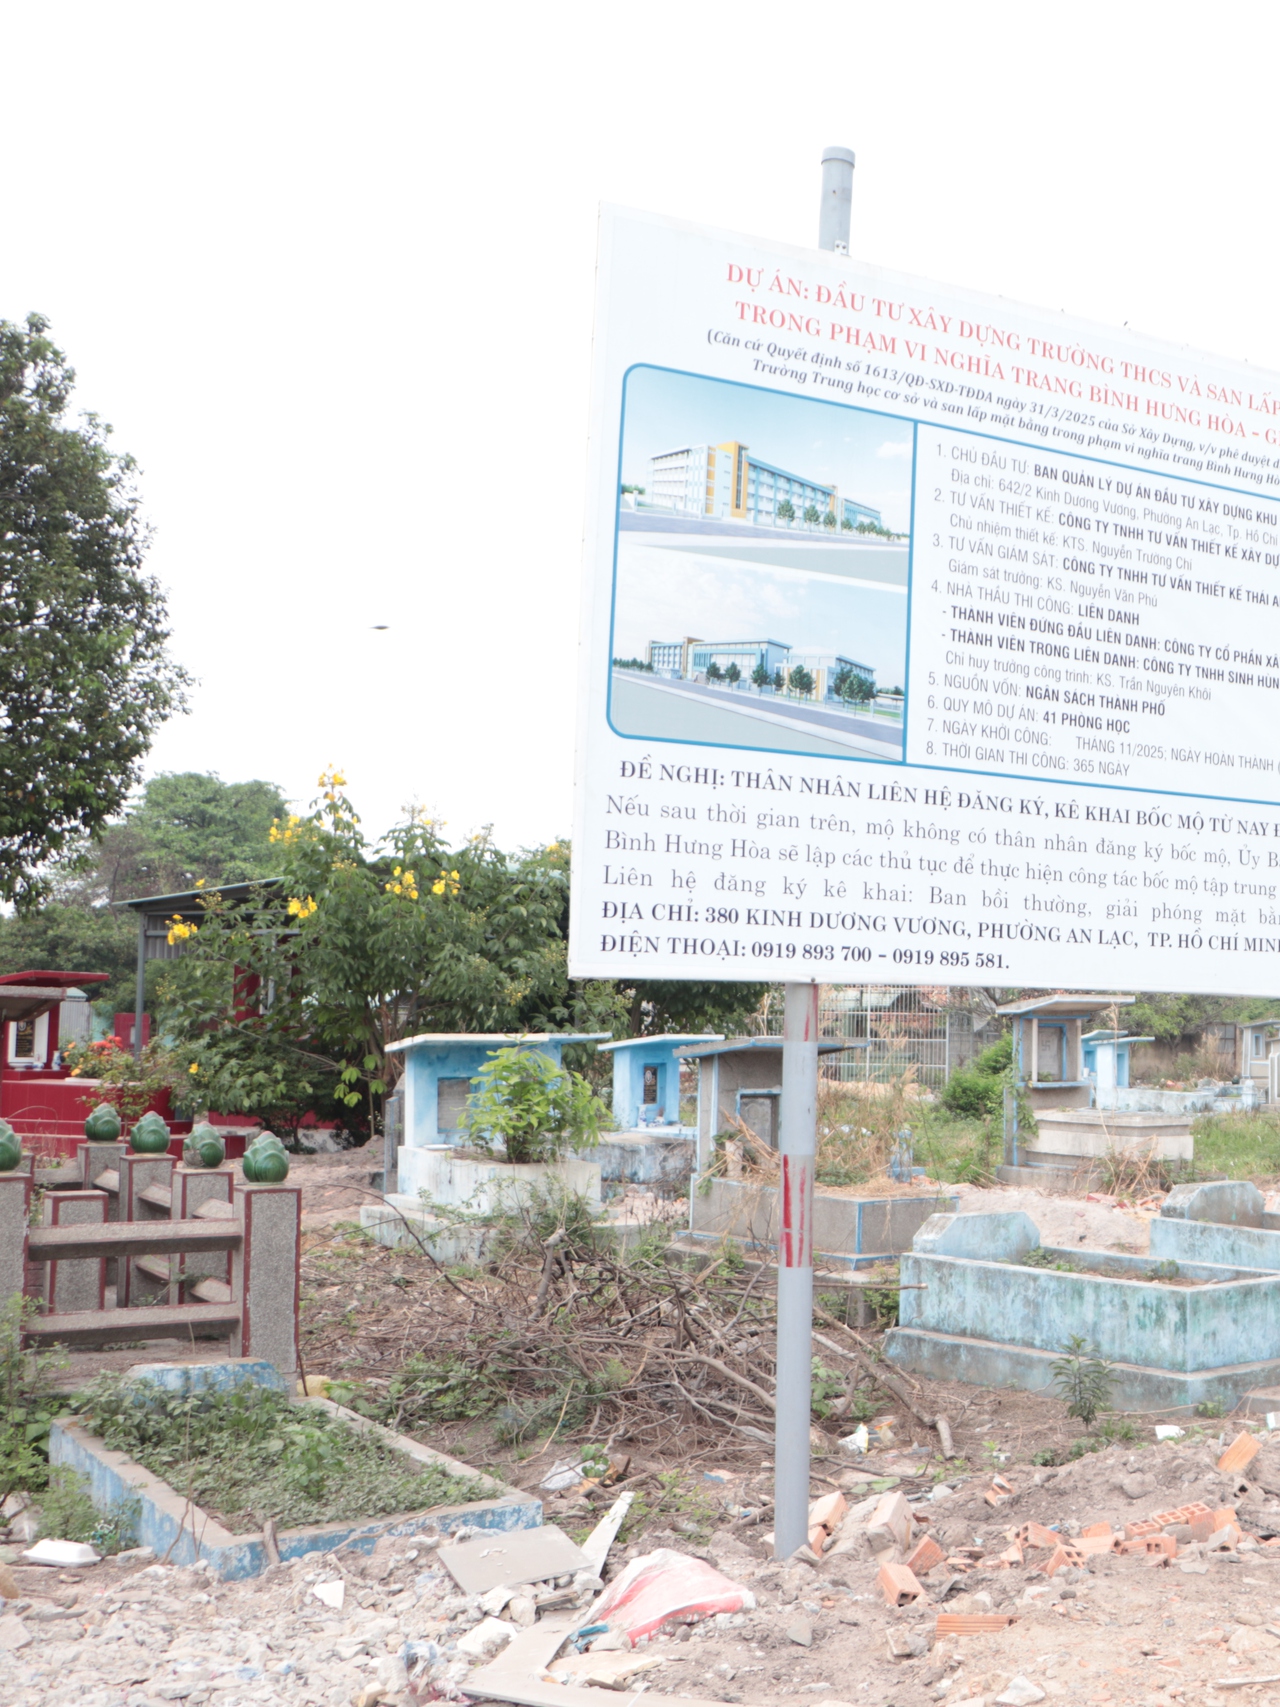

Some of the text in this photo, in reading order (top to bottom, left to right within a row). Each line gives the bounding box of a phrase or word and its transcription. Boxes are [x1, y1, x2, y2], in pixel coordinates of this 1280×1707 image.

[726, 262, 765, 294] DỰ
[767, 267, 810, 301] ÁN:
[814, 279, 866, 313] ĐẦU
[871, 297, 906, 323] TƯ
[907, 305, 954, 335] XÂY
[958, 319, 1022, 352] DỰNG
[1026, 336, 1115, 375] TRƯỜNG
[1119, 360, 1173, 390] THCS
[1176, 373, 1203, 398] VÀ
[1205, 382, 1243, 407] SAN
[706, 327, 742, 348] (Căn
[743, 337, 765, 353] cứ
[765, 341, 809, 363] Quyết
[809, 350, 843, 370] định
[844, 359, 863, 374] số
[863, 362, 994, 404] 1613/QĐ-SXD-TĐDA
[995, 395, 1028, 414] ngày
[1028, 400, 1097, 428] 31/3/2025
[1097, 417, 1120, 433] của
[1120, 422, 1138, 437] Sở
[1137, 425, 1161, 445] Xây
[1161, 431, 1197, 453] Dựng,
[1198, 441, 1218, 456] v/v
[1217, 445, 1240, 461] phê
[1240, 450, 1272, 469] duyệt
[734, 299, 822, 338] TRONG
[828, 321, 898, 356] PHẠM
[903, 338, 928, 363] VI
[933, 346, 1006, 382] NGHĨA
[1010, 365, 1083, 400] TRANG
[1088, 382, 1140, 413] BÌNH
[1145, 397, 1202, 428] HƯNG
[1206, 412, 1247, 439] HÒA
[936, 442, 947, 458] 1.
[950, 444, 978, 465] CHỦ
[1010, 457, 1030, 476] TƯ:
[1033, 462, 1059, 482] BAN
[1097, 475, 1114, 493] LÝ
[1115, 479, 1134, 500] DỰ
[1134, 481, 1152, 501] ÁN
[1179, 493, 1197, 510] TƯ
[1197, 496, 1221, 515] XÂY
[1222, 502, 1254, 522] DỰNG
[1255, 509, 1279, 528] KHU
[932, 532, 944, 549] 3.
[947, 534, 966, 553] TƯ
[967, 536, 994, 558] VẤN
[996, 543, 1030, 564] GIÁM
[1031, 549, 1059, 570] SÁT:
[1061, 554, 1096, 576] CÔNG
[1098, 562, 1115, 579] TY
[1115, 565, 1149, 586] TNHH
[1150, 571, 1168, 589] TƯ
[1168, 572, 1193, 593] VẤN
[1194, 579, 1227, 599] THIẾT
[1228, 583, 1244, 602] KẾ
[1244, 588, 1270, 607] THÁI
[948, 512, 974, 531] Chủ
[976, 519, 1012, 538] nhiệm
[1014, 525, 1040, 544] thiết
[1042, 530, 1059, 547] kế:
[1061, 534, 1089, 553] KTS.
[1135, 547, 1173, 571] Trường
[947, 557, 980, 578] Giám
[982, 565, 1001, 582] sát
[1002, 568, 1043, 591] trưởng:
[1046, 575, 1067, 593] KS.
[1113, 586, 1135, 604] Văn
[1137, 590, 1159, 608] Phú
[949, 626, 994, 649] THÀNH
[996, 633, 1026, 654] VIÊN
[1027, 639, 1071, 661] TRONG
[1072, 644, 1101, 665] LIÊN
[1102, 650, 1140, 670] DANH:
[1142, 654, 1176, 676] CÔNG
[1176, 661, 1193, 678] TY
[1194, 664, 1226, 683] TNHH
[1227, 669, 1255, 687] SINH
[924, 739, 1131, 778] 8. THỜI GIAN THI CÔNG: 365 NGÀY
[618, 752, 653, 781] ĐỀ
[658, 762, 726, 791] NGHỊ:
[730, 767, 794, 793] THÂN
[798, 773, 863, 799] NHÂN
[866, 779, 919, 804] LIÊN
[923, 784, 953, 812] HỆ
[956, 788, 1014, 814] ĐĂNG
[1018, 794, 1050, 821] KÝ,
[1053, 798, 1081, 821] KÊ
[1084, 804, 1131, 825] KHAI
[1135, 804, 1173, 829] BỐC
[1176, 810, 1206, 836] MỘ
[1207, 812, 1235, 834] TỪ
[1235, 818, 1271, 838] NAY
[599, 928, 662, 959] ĐIỆN
[665, 935, 747, 962] THOẠI:
[750, 940, 798, 960] 0919
[801, 942, 836, 962] 893
[839, 944, 873, 964] 700
[891, 946, 936, 967] 0919
[938, 949, 971, 968] 895
[974, 951, 1011, 970] 581.
[600, 899, 646, 925] ĐỊA
[650, 897, 700, 924] CHỈ:
[704, 905, 741, 925] 380
[744, 907, 804, 929] KINH
[808, 909, 889, 933] DƯƠNG
[891, 914, 973, 942] VƯƠNG,
[976, 917, 1063, 944] PHƯỜNG
[1065, 926, 1094, 945] AN
[1096, 928, 1139, 951] LẠC,
[1146, 930, 1174, 949] TP.
[1176, 925, 1204, 950] HỒ
[1207, 931, 1240, 952] CHÍ
